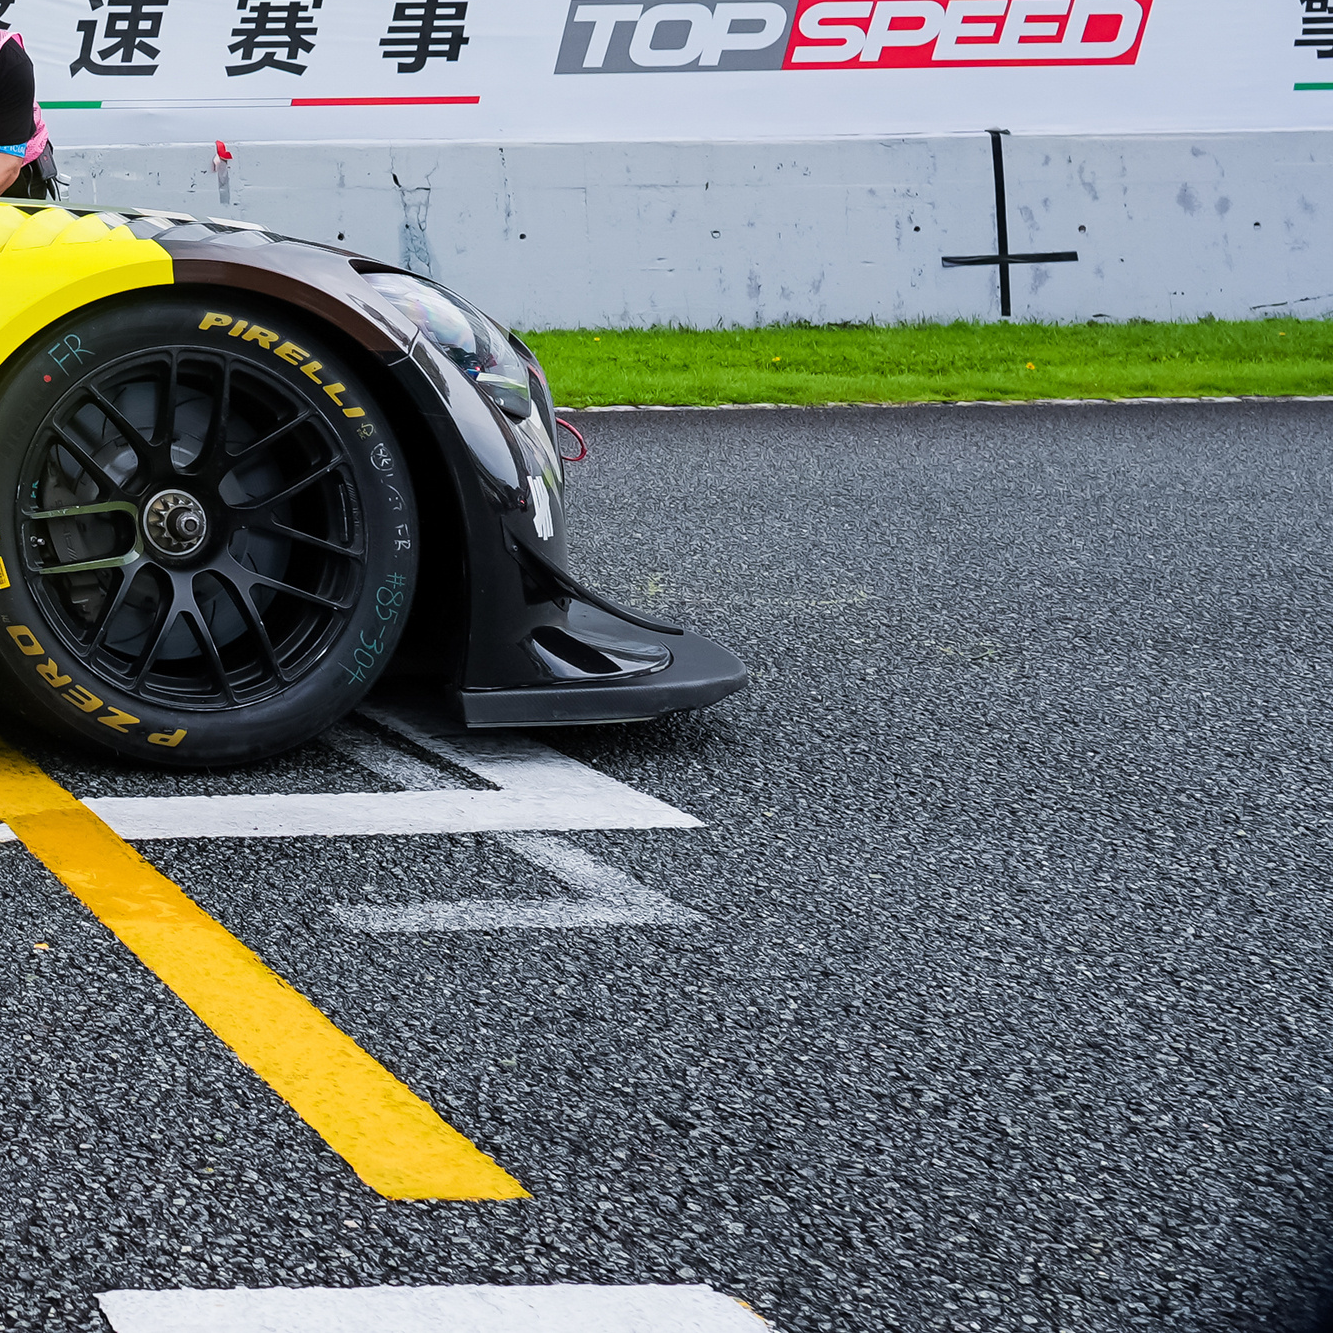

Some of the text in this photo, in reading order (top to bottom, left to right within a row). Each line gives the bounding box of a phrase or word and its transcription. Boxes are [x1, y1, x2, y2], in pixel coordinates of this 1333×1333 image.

[47, 333, 96, 377] FR
[197, 311, 366, 419] PIRELLI
[5, 624, 141, 734] ZERO
[337, 571, 407, 686] #85-304
